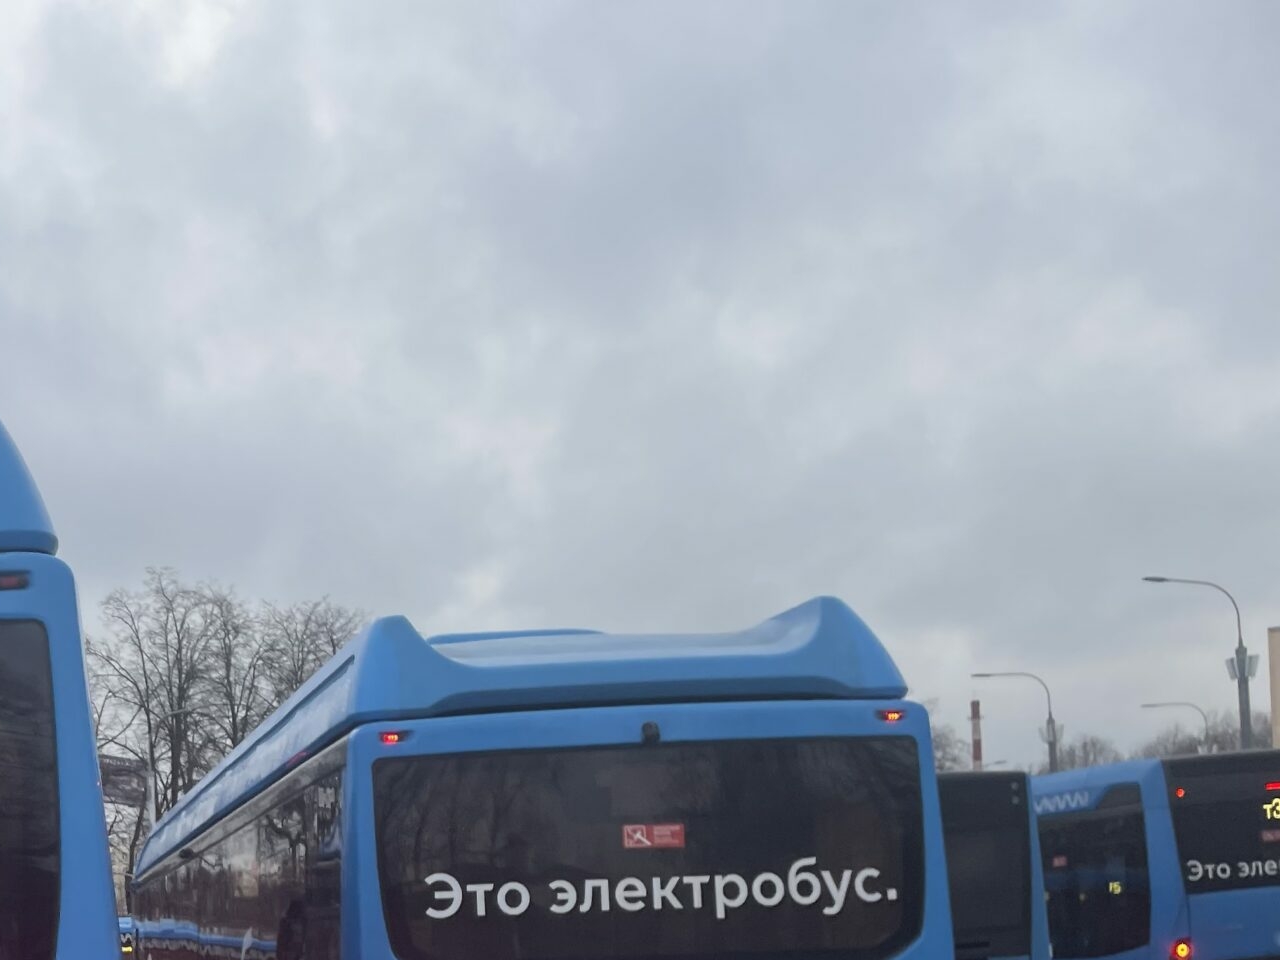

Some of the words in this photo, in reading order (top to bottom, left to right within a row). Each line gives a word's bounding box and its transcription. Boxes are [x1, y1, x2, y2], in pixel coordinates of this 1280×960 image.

[424, 873, 530, 919] Это
[549, 857, 898, 919] электробус.
[1187, 859, 1231, 881] Это
[1237, 859, 1280, 878] эле
